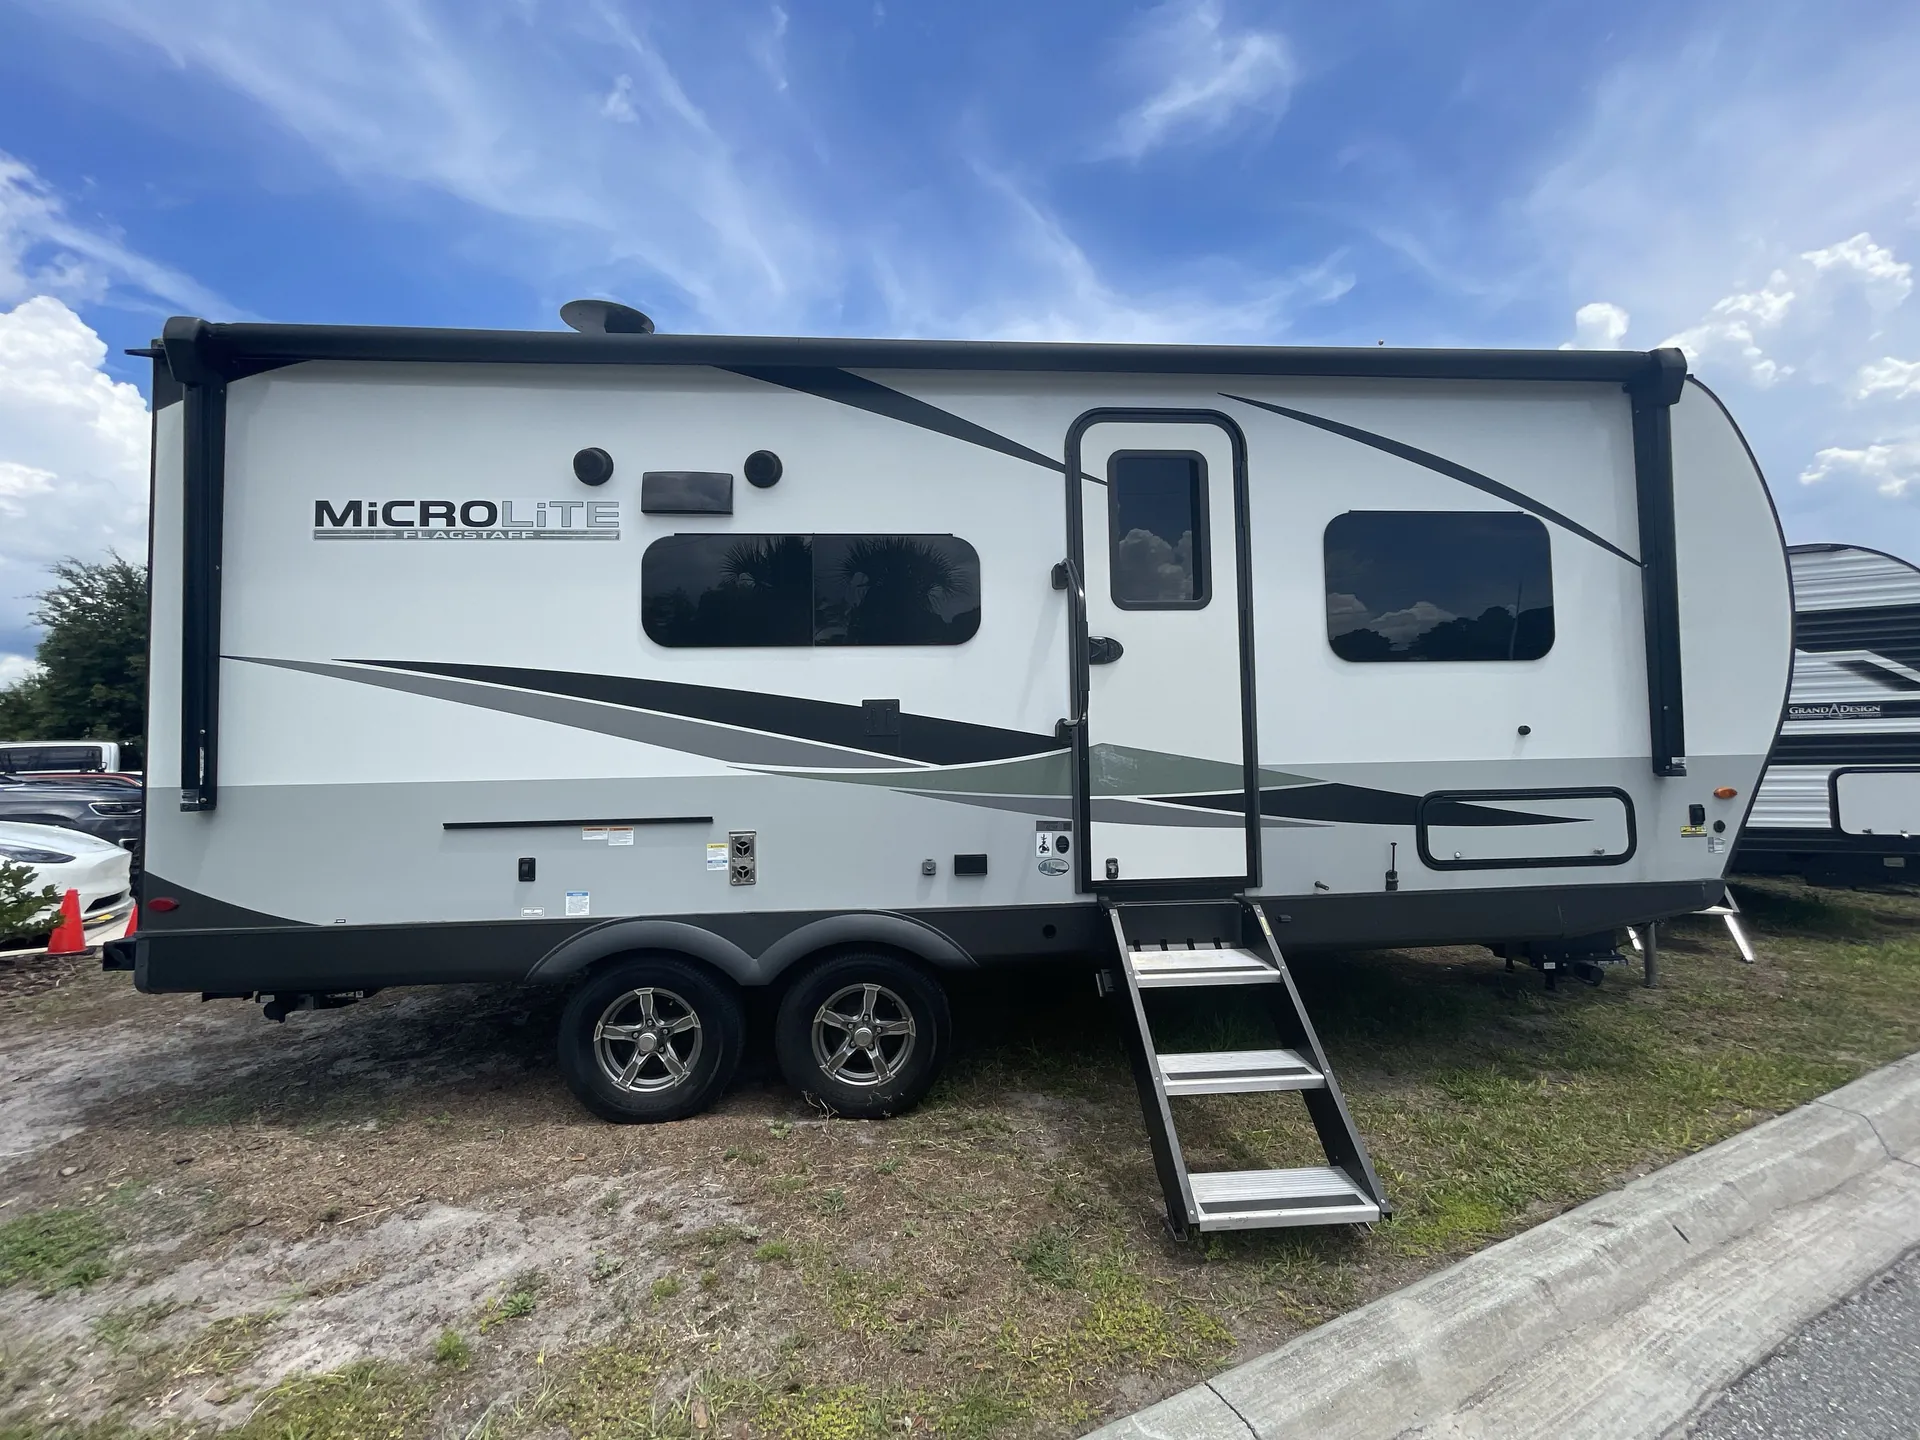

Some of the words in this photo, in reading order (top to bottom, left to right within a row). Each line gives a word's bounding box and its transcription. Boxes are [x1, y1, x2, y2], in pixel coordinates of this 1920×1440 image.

[403, 531, 535, 539] FLAGSTAFF
[1789, 706, 1829, 714] GRAND
[1840, 705, 1881, 713] DESIGN
